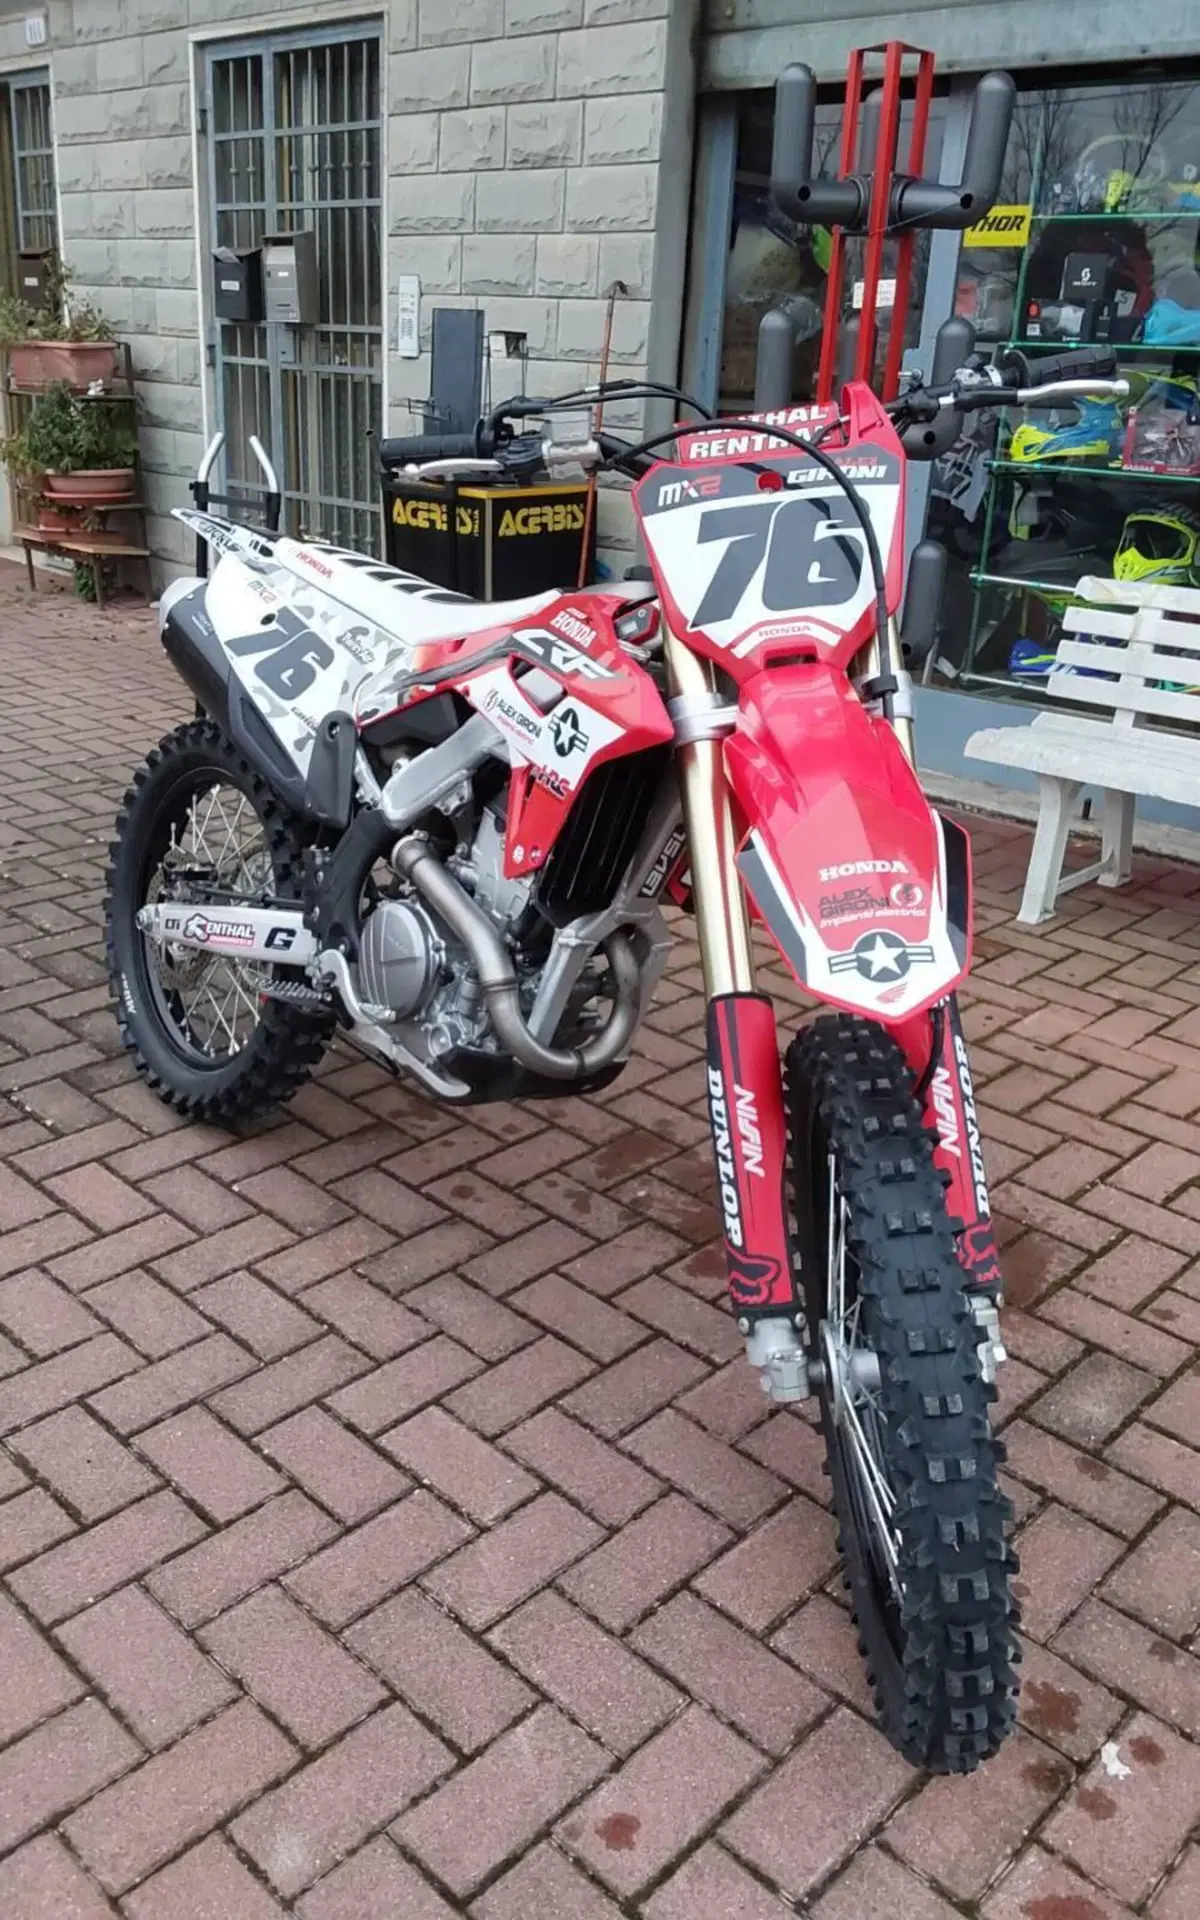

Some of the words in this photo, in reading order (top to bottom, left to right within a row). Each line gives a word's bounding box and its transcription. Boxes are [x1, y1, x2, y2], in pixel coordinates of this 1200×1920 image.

[658, 475, 722, 507] MX2
[690, 495, 870, 629] 76
[549, 610, 597, 648] HONDA
[758, 624, 812, 638] HONDA
[224, 605, 335, 701] 76
[818, 859, 909, 882] HONDA
[819, 886, 872, 907] ALEX
[954, 1035, 991, 1217] DUNLOP
[708, 1065, 744, 1248] DUNLOP
